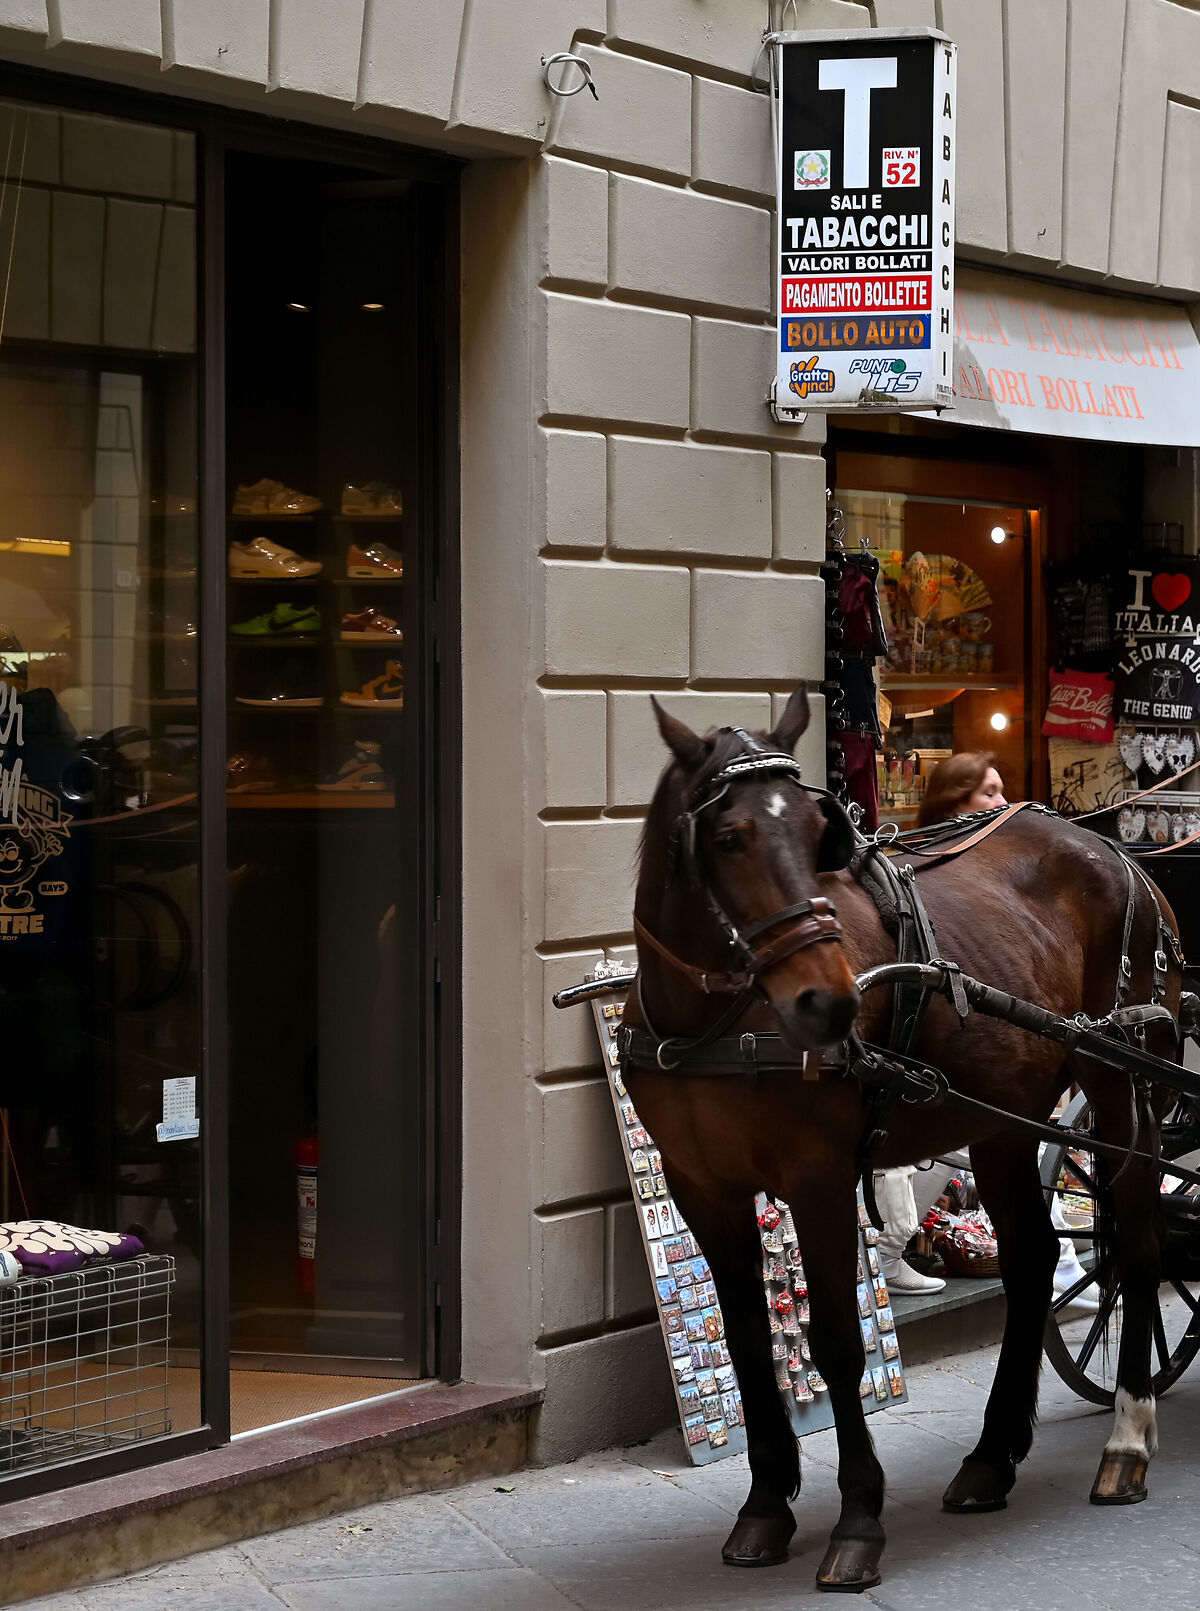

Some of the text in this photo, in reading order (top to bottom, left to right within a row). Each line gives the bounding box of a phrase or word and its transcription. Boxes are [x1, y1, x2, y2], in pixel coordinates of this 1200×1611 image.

[818, 57, 898, 189] T
[884, 150, 904, 160] RIV.
[886, 162, 916, 185] 52
[830, 193, 882, 211] SALI E
[938, 49, 953, 377] TABACCHI
[786, 213, 928, 249] TABACCHI
[787, 254, 927, 272] VALORI BOLLATI
[786, 280, 927, 308] PAGAMENTO BOLLETTE
[788, 319, 925, 346] BOLLO AUTO
[1009, 299, 1184, 370] TABACCHI
[791, 370, 829, 382] Gratta
[952, 366, 1036, 408] ALORI
[1037, 375, 1145, 420] BOLLATI
[1127, 569, 1153, 612] I
[1114, 612, 1195, 635] ITALIA
[1069, 687, 1114, 718] Bella
[1123, 699, 1151, 717] THE
